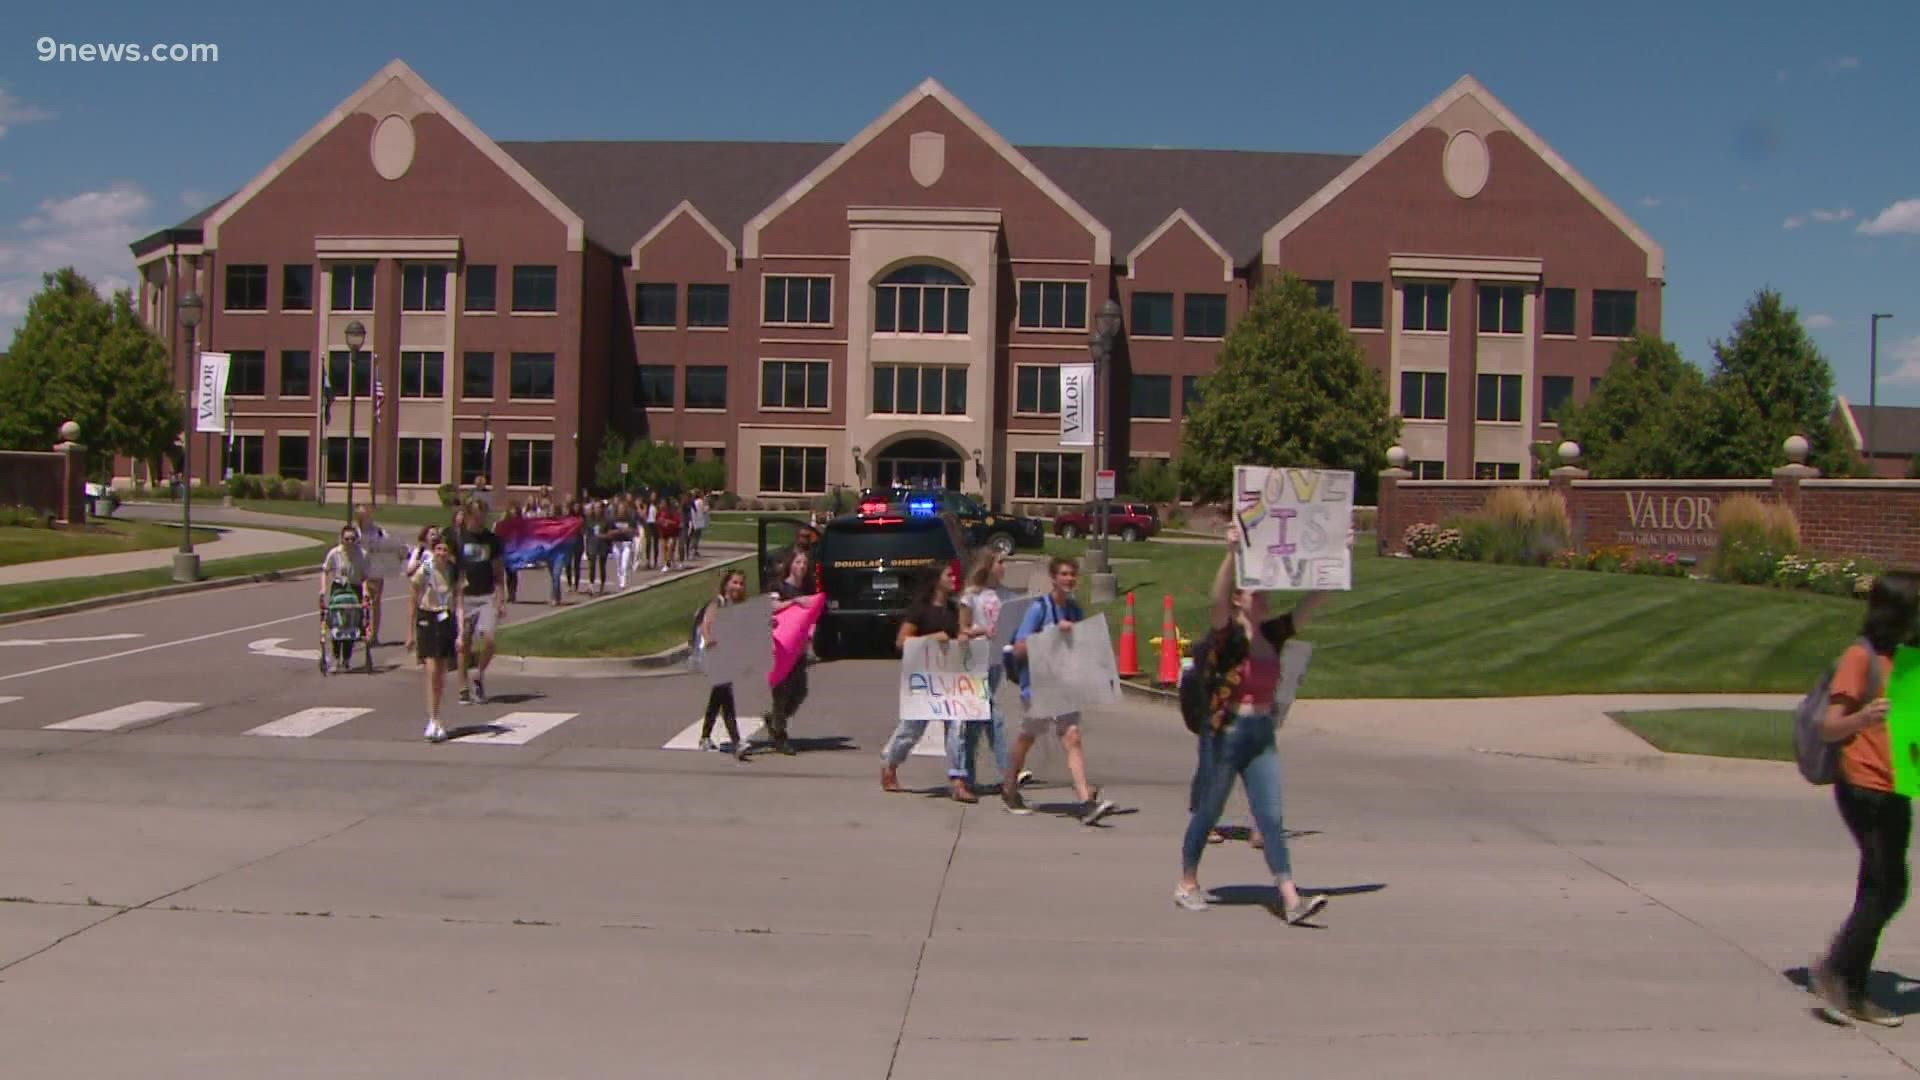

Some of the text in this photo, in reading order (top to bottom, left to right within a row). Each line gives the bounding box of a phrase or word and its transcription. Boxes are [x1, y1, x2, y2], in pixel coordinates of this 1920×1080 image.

[199, 364, 215, 420] VALOR
[1063, 375, 1080, 433] VALOR
[1238, 469, 1350, 504] LOVE
[1267, 505, 1329, 555] IS
[1625, 491, 1714, 531] VALOR
[834, 559, 881, 568] DOUGLAS
[1239, 554, 1345, 587] LOVE
